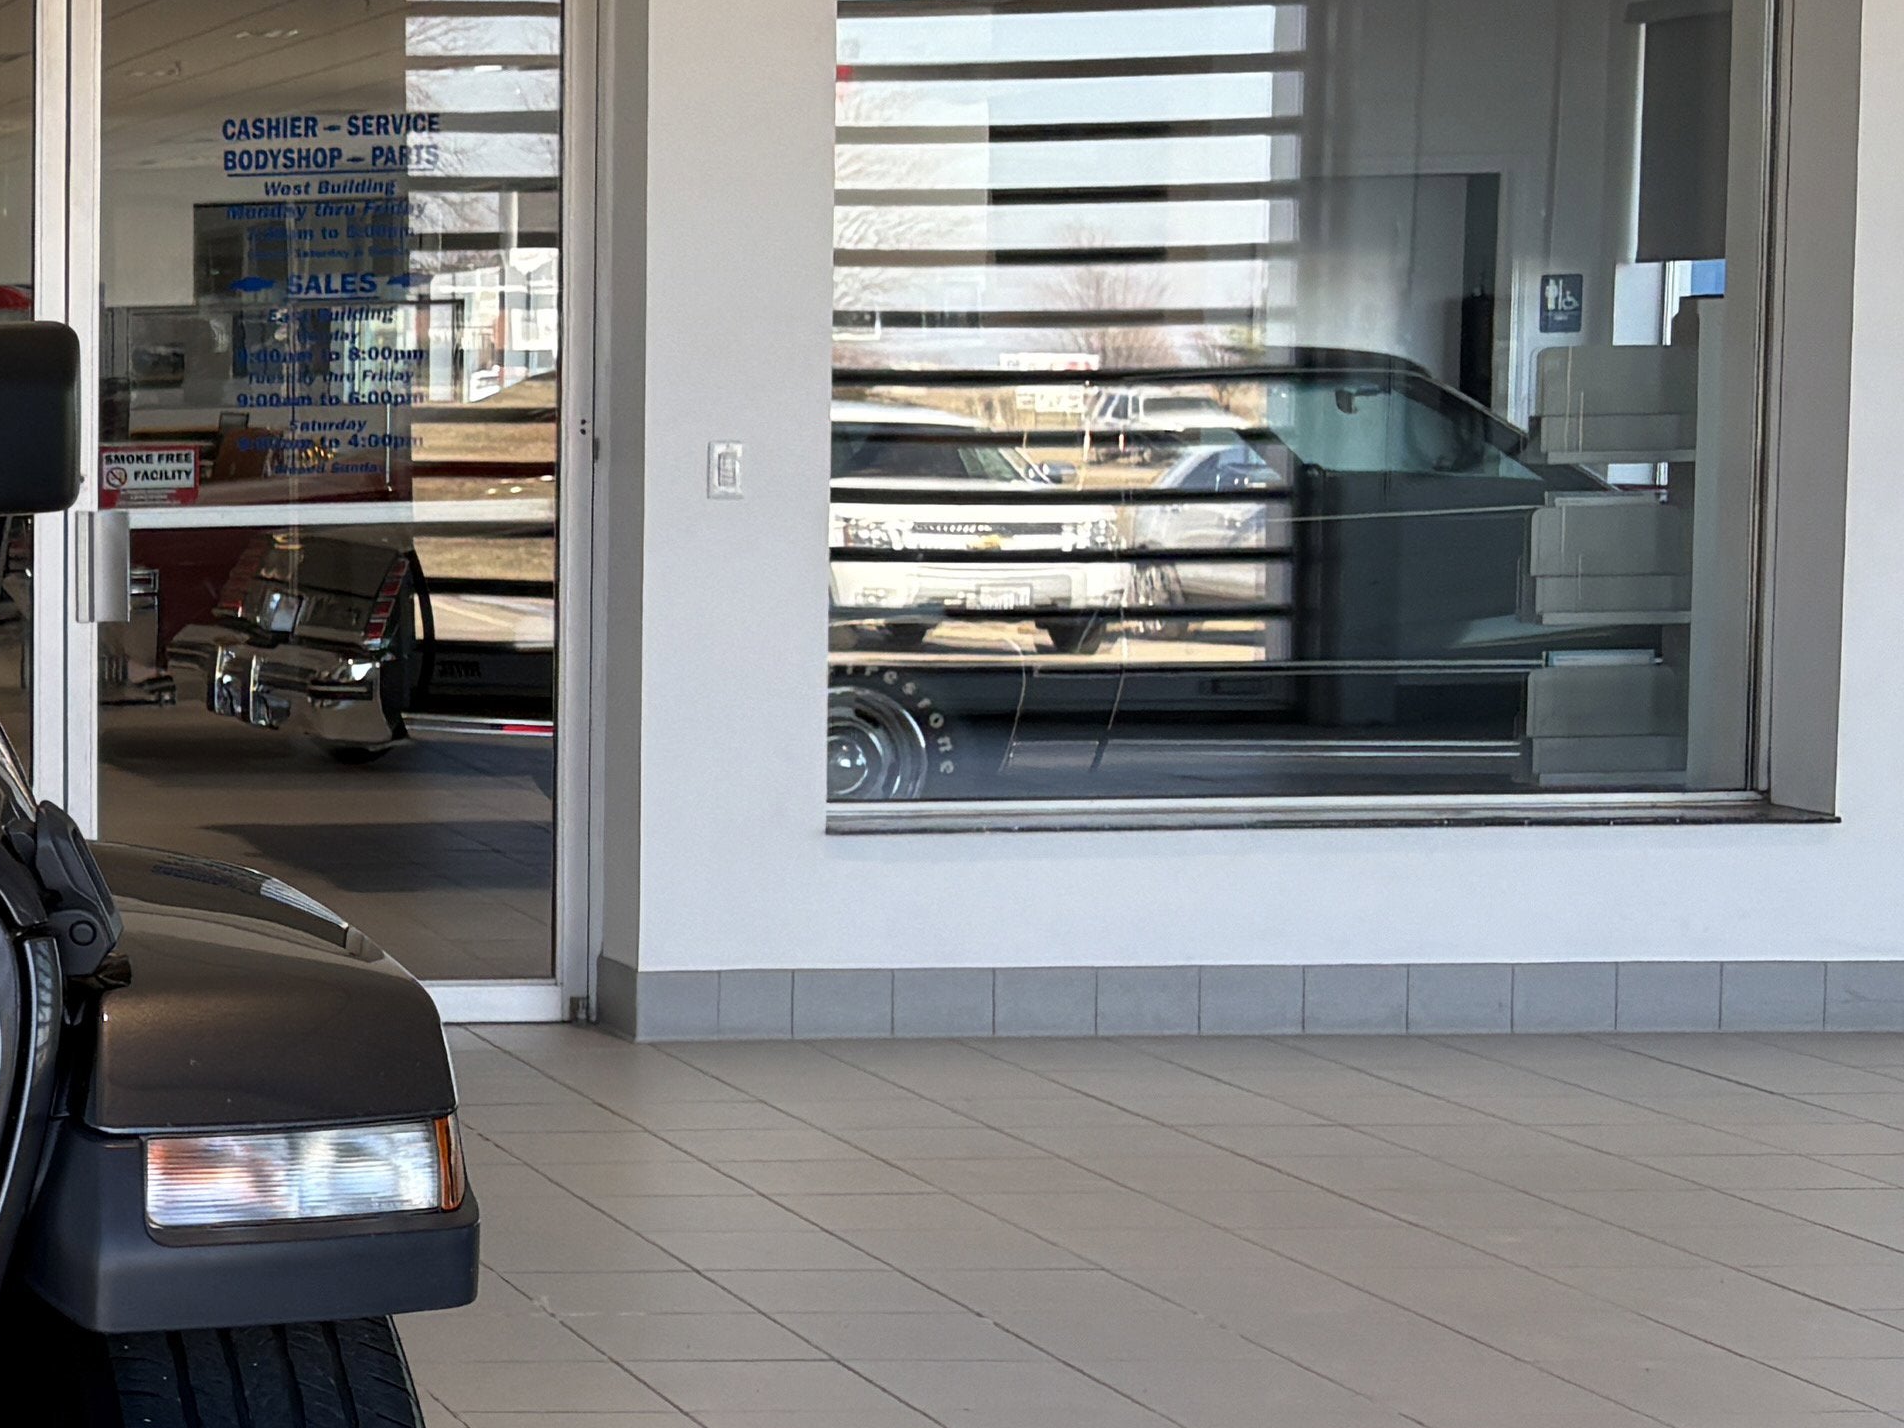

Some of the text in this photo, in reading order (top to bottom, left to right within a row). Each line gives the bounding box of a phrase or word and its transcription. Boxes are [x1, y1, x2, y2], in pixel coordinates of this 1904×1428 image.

[222, 113, 440, 141] CASHIER SERVICE
[224, 144, 439, 171] BODYSHOP PARTS
[264, 178, 396, 196] West Building
[315, 202, 355, 217] thru
[321, 226, 339, 239] to
[288, 273, 377, 294] SALES
[348, 345, 424, 364] 8:00pm
[249, 372, 315, 386] Tuesy
[362, 369, 415, 384] Friday
[236, 390, 425, 409] 9:00am to 6:00pm
[289, 420, 367, 433] Saturday
[320, 434, 341, 449] to
[348, 432, 424, 450] 4:00pm
[104, 452, 192, 465] SMOKE FREE
[133, 469, 192, 481] FACILITY
